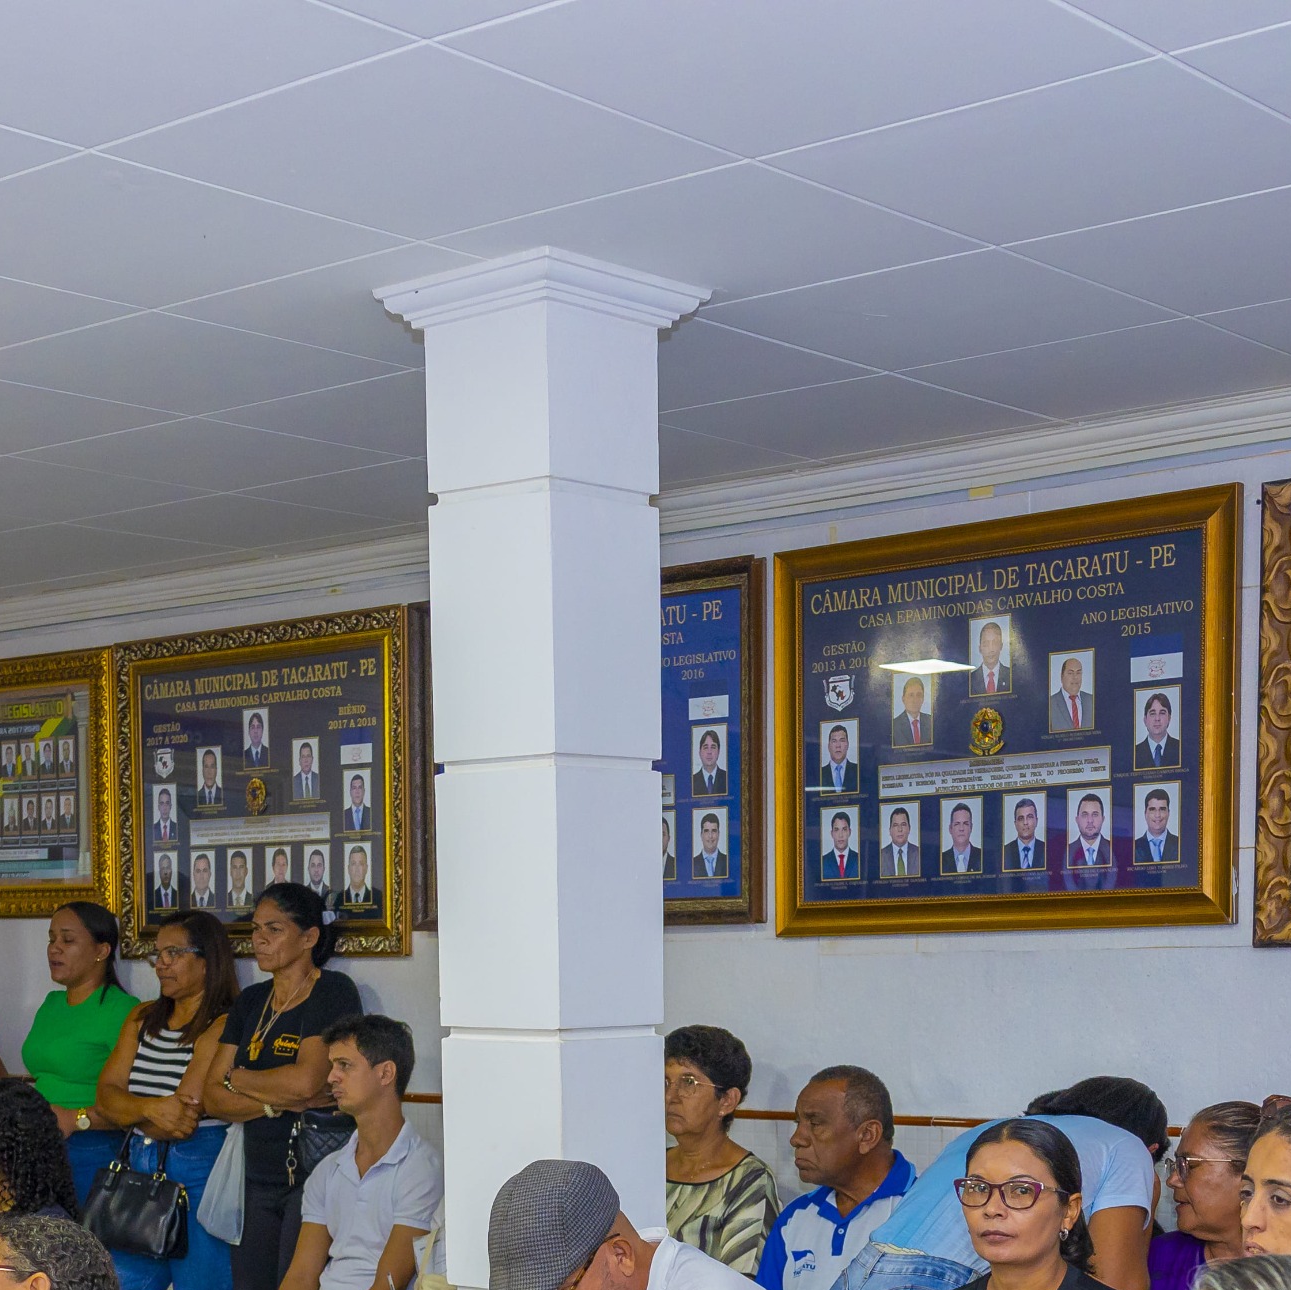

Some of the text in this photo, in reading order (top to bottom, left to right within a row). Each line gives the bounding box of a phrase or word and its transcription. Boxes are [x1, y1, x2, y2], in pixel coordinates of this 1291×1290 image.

[811, 587, 882, 615] CÂMARA
[887, 571, 987, 605] MUNICIPAL
[993, 566, 1020, 590] DE
[1025, 550, 1129, 586] TACARATU
[1149, 543, 1176, 570] PE
[702, 600, 722, 621] PE
[859, 582, 1125, 628] CASA EPAMINONDAS CARVALHO COSTA
[1081, 600, 1194, 625] ANO LEGISLATIVO
[1121, 622, 1151, 637] 2015
[673, 650, 736, 667] LEGISLATIVO
[822, 641, 866, 657] GESTÃO
[681, 668, 705, 680] 2016
[812, 660, 836, 673] 2013
[838, 659, 846, 670] A
[145, 679, 191, 700] CÂMARA
[195, 672, 258, 695] MUNICIPAL
[262, 669, 278, 687] DE
[282, 661, 348, 685] TACARATU
[359, 658, 376, 676] PE
[175, 686, 342, 713] CASA EPAMINONDAS CARVALHO COSTA
[328, 719, 347, 729] 2017
